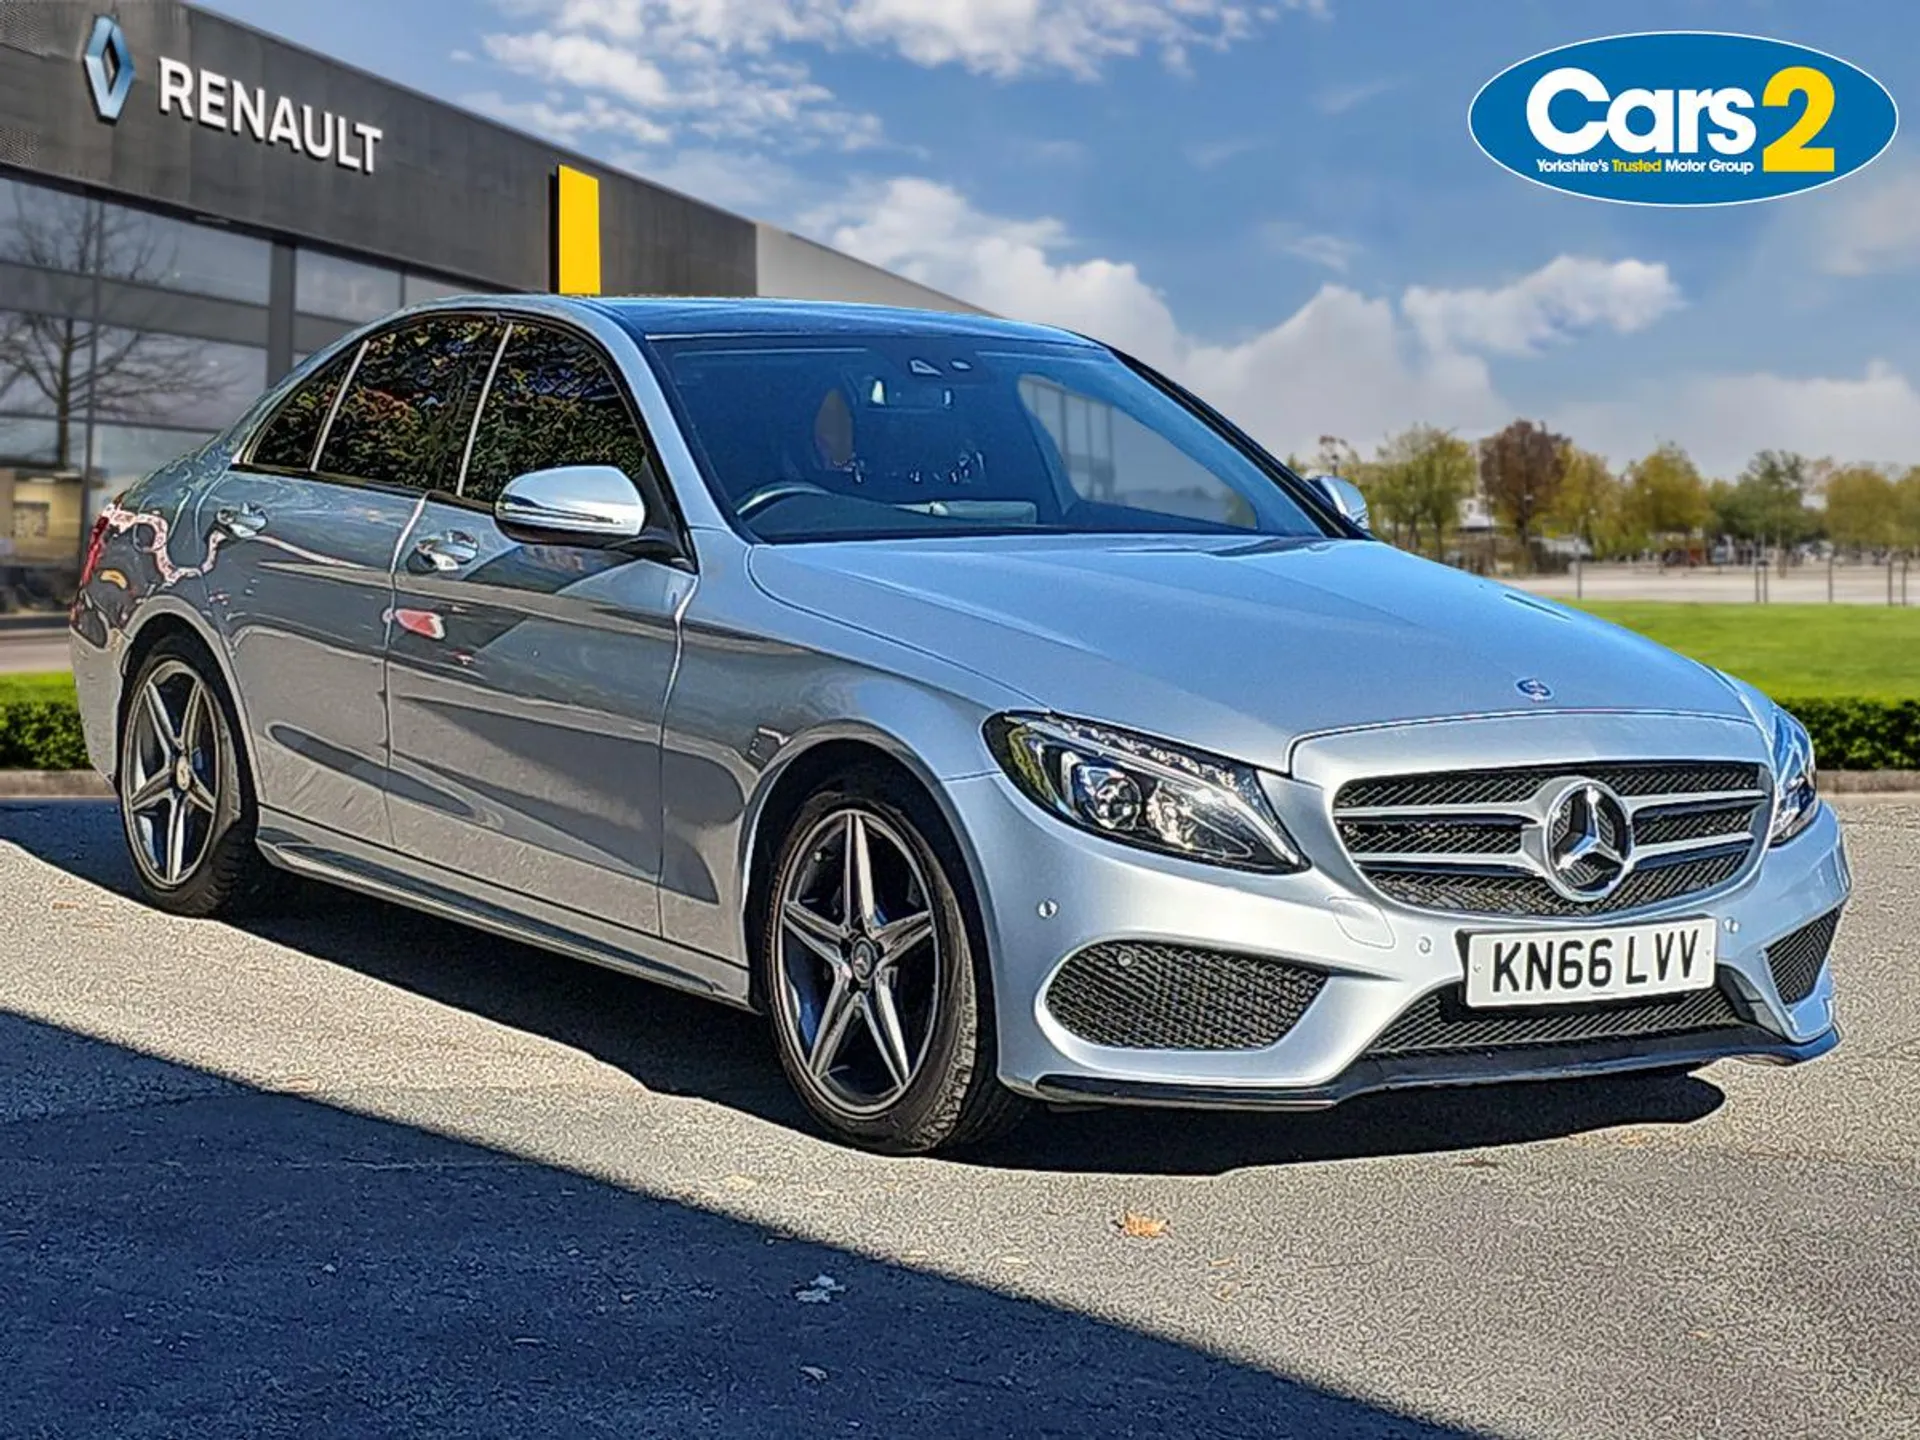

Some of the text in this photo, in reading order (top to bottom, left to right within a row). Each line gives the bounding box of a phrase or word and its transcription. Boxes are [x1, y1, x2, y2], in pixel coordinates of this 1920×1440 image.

[159, 56, 383, 174] RENAULT
[1492, 929, 1700, 993] KN66 LVV
